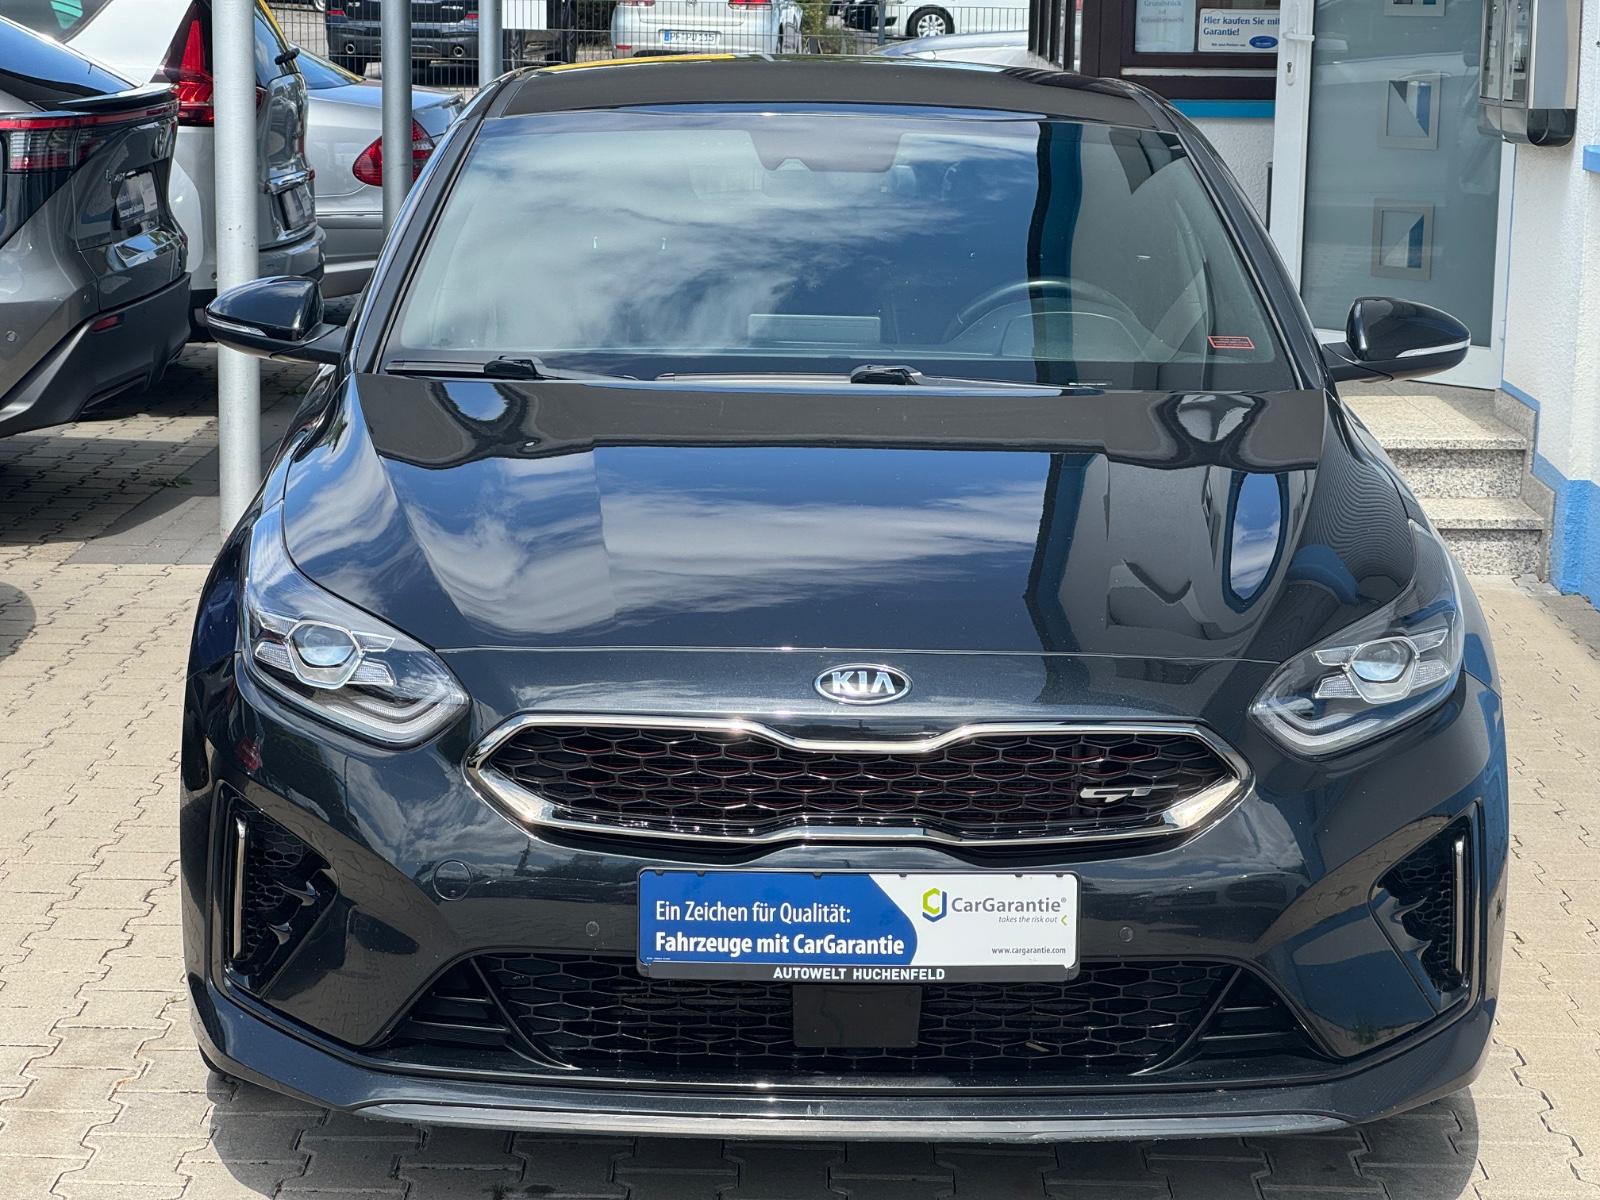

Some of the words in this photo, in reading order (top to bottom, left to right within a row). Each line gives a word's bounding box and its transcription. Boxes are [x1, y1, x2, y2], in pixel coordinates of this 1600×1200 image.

[1203, 16, 1221, 25] Hier
[1222, 17, 1250, 25] kaufen
[1252, 17, 1265, 25] Sie
[1203, 27, 1240, 36] Garantie!
[831, 671, 896, 694] KIA
[656, 900, 681, 921] Ein
[684, 901, 748, 922] Zeichen
[752, 901, 777, 922] für
[780, 902, 851, 925] Qualität:
[998, 916, 1018, 924] takes
[1019, 916, 1030, 924] the
[1031, 916, 1044, 924] risk
[655, 931, 753, 958] Fahrzeuge
[756, 933, 790, 954] mit
[793, 933, 905, 956] CarGarantie
[991, 946, 1067, 956] www.cargarantie.com
[773, 967, 847, 980] AUTOWELT
[852, 968, 945, 981] HUCHENFELD
